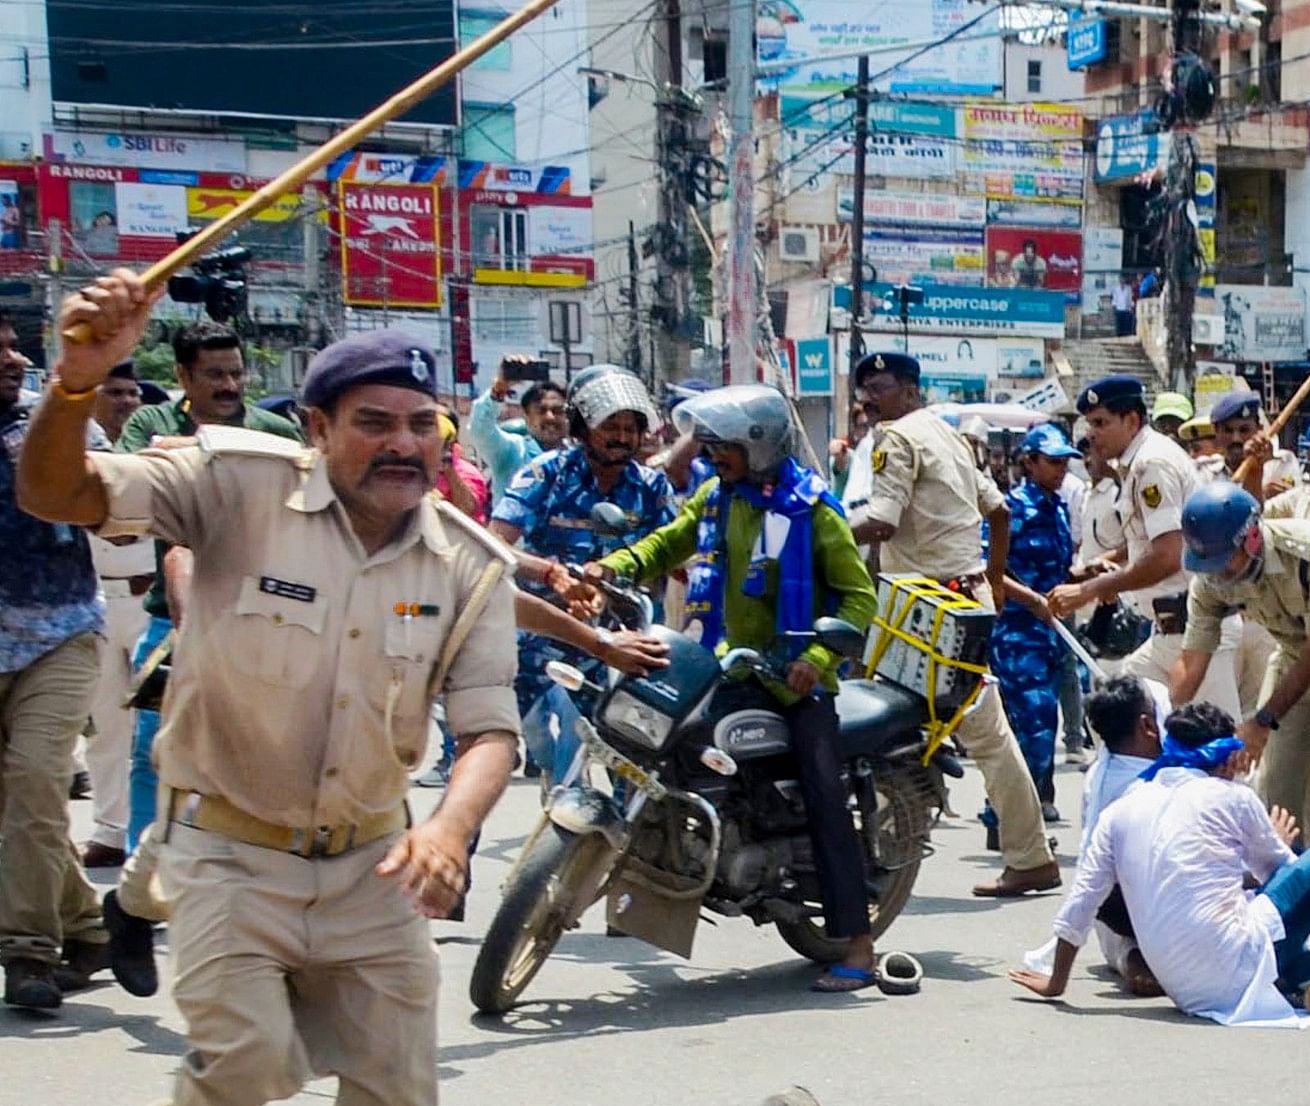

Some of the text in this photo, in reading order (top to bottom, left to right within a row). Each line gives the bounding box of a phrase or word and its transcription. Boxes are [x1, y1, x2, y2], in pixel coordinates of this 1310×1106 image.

[124, 135, 187, 154] SBI Life
[50, 165, 122, 181] RANGOLI
[345, 192, 431, 214] RANGOLI
[923, 296, 1009, 312] uppercase
[886, 317, 1015, 329] ANHYA ENTERPRISES
[914, 352, 948, 361] AMELI
